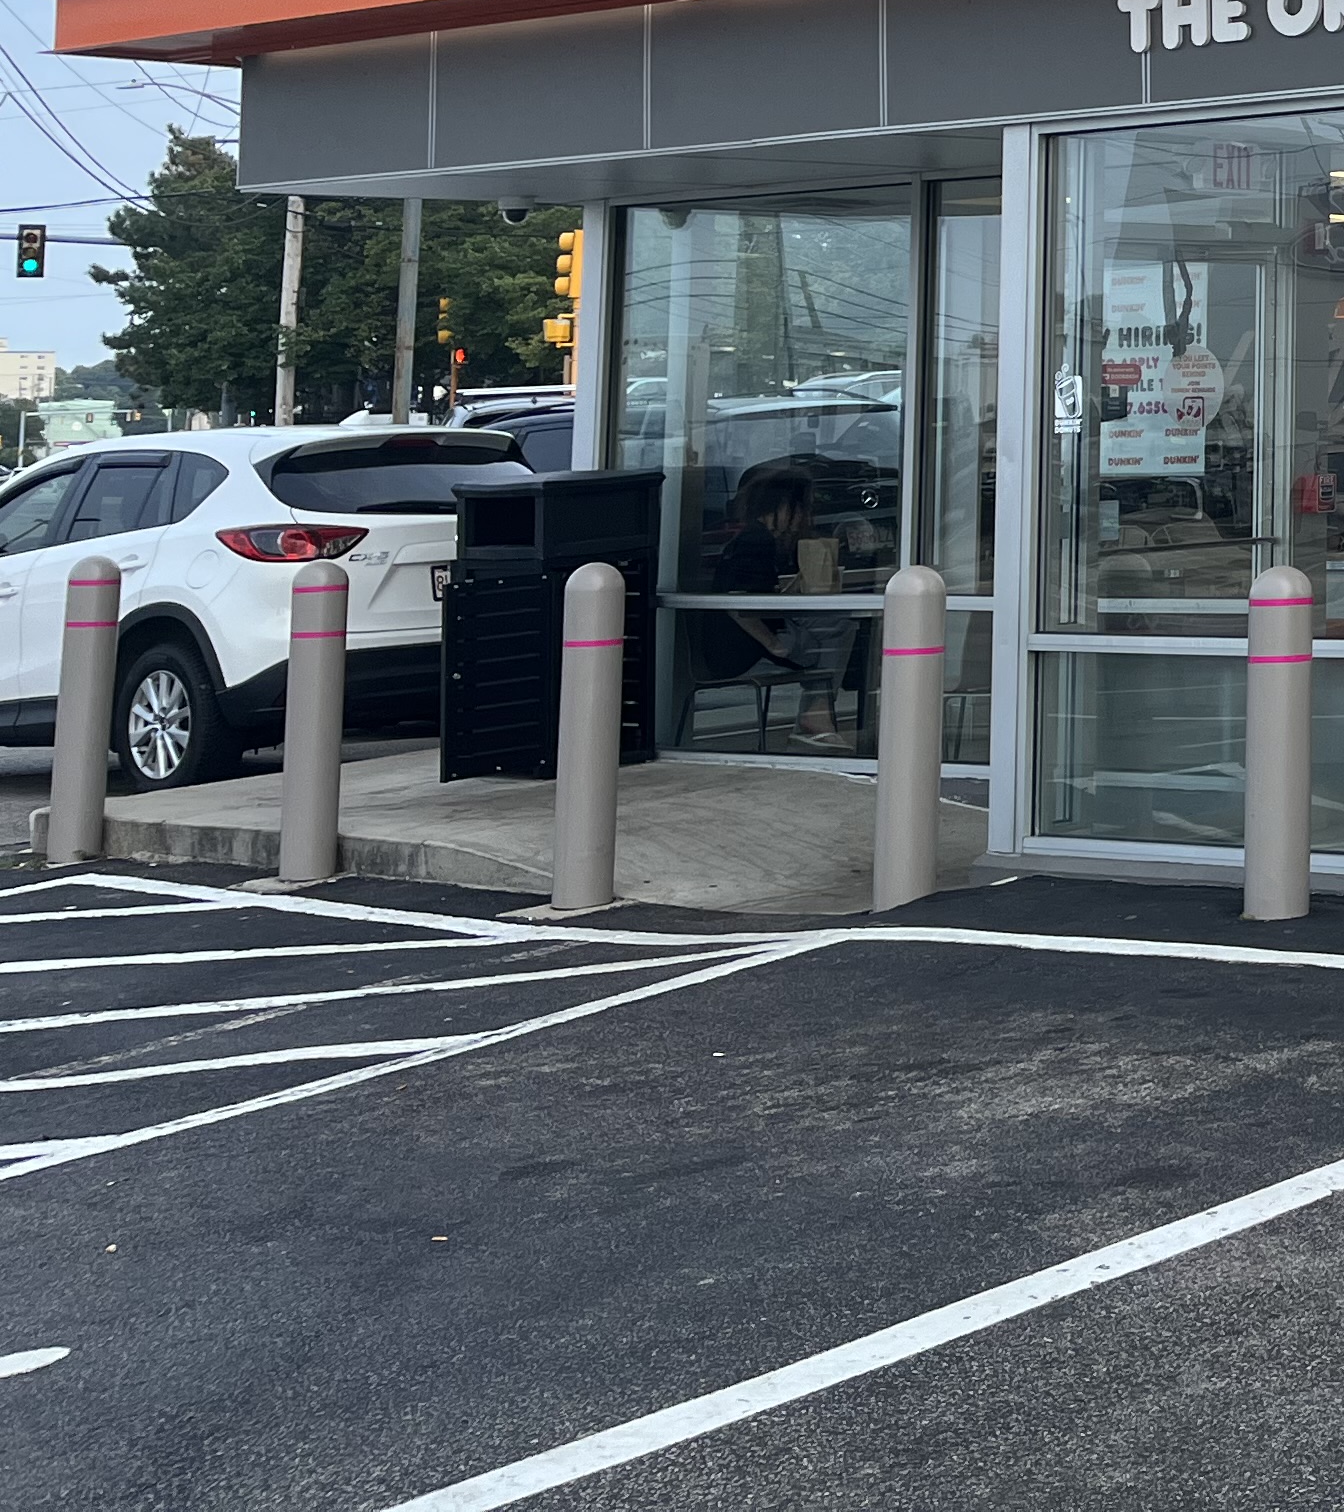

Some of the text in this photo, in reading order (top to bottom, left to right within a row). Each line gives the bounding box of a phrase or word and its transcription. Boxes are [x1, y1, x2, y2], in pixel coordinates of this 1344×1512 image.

[1212, 143, 1253, 189] EXIT
[1107, 453, 1200, 467] DUNKIN' DUNKIN'
